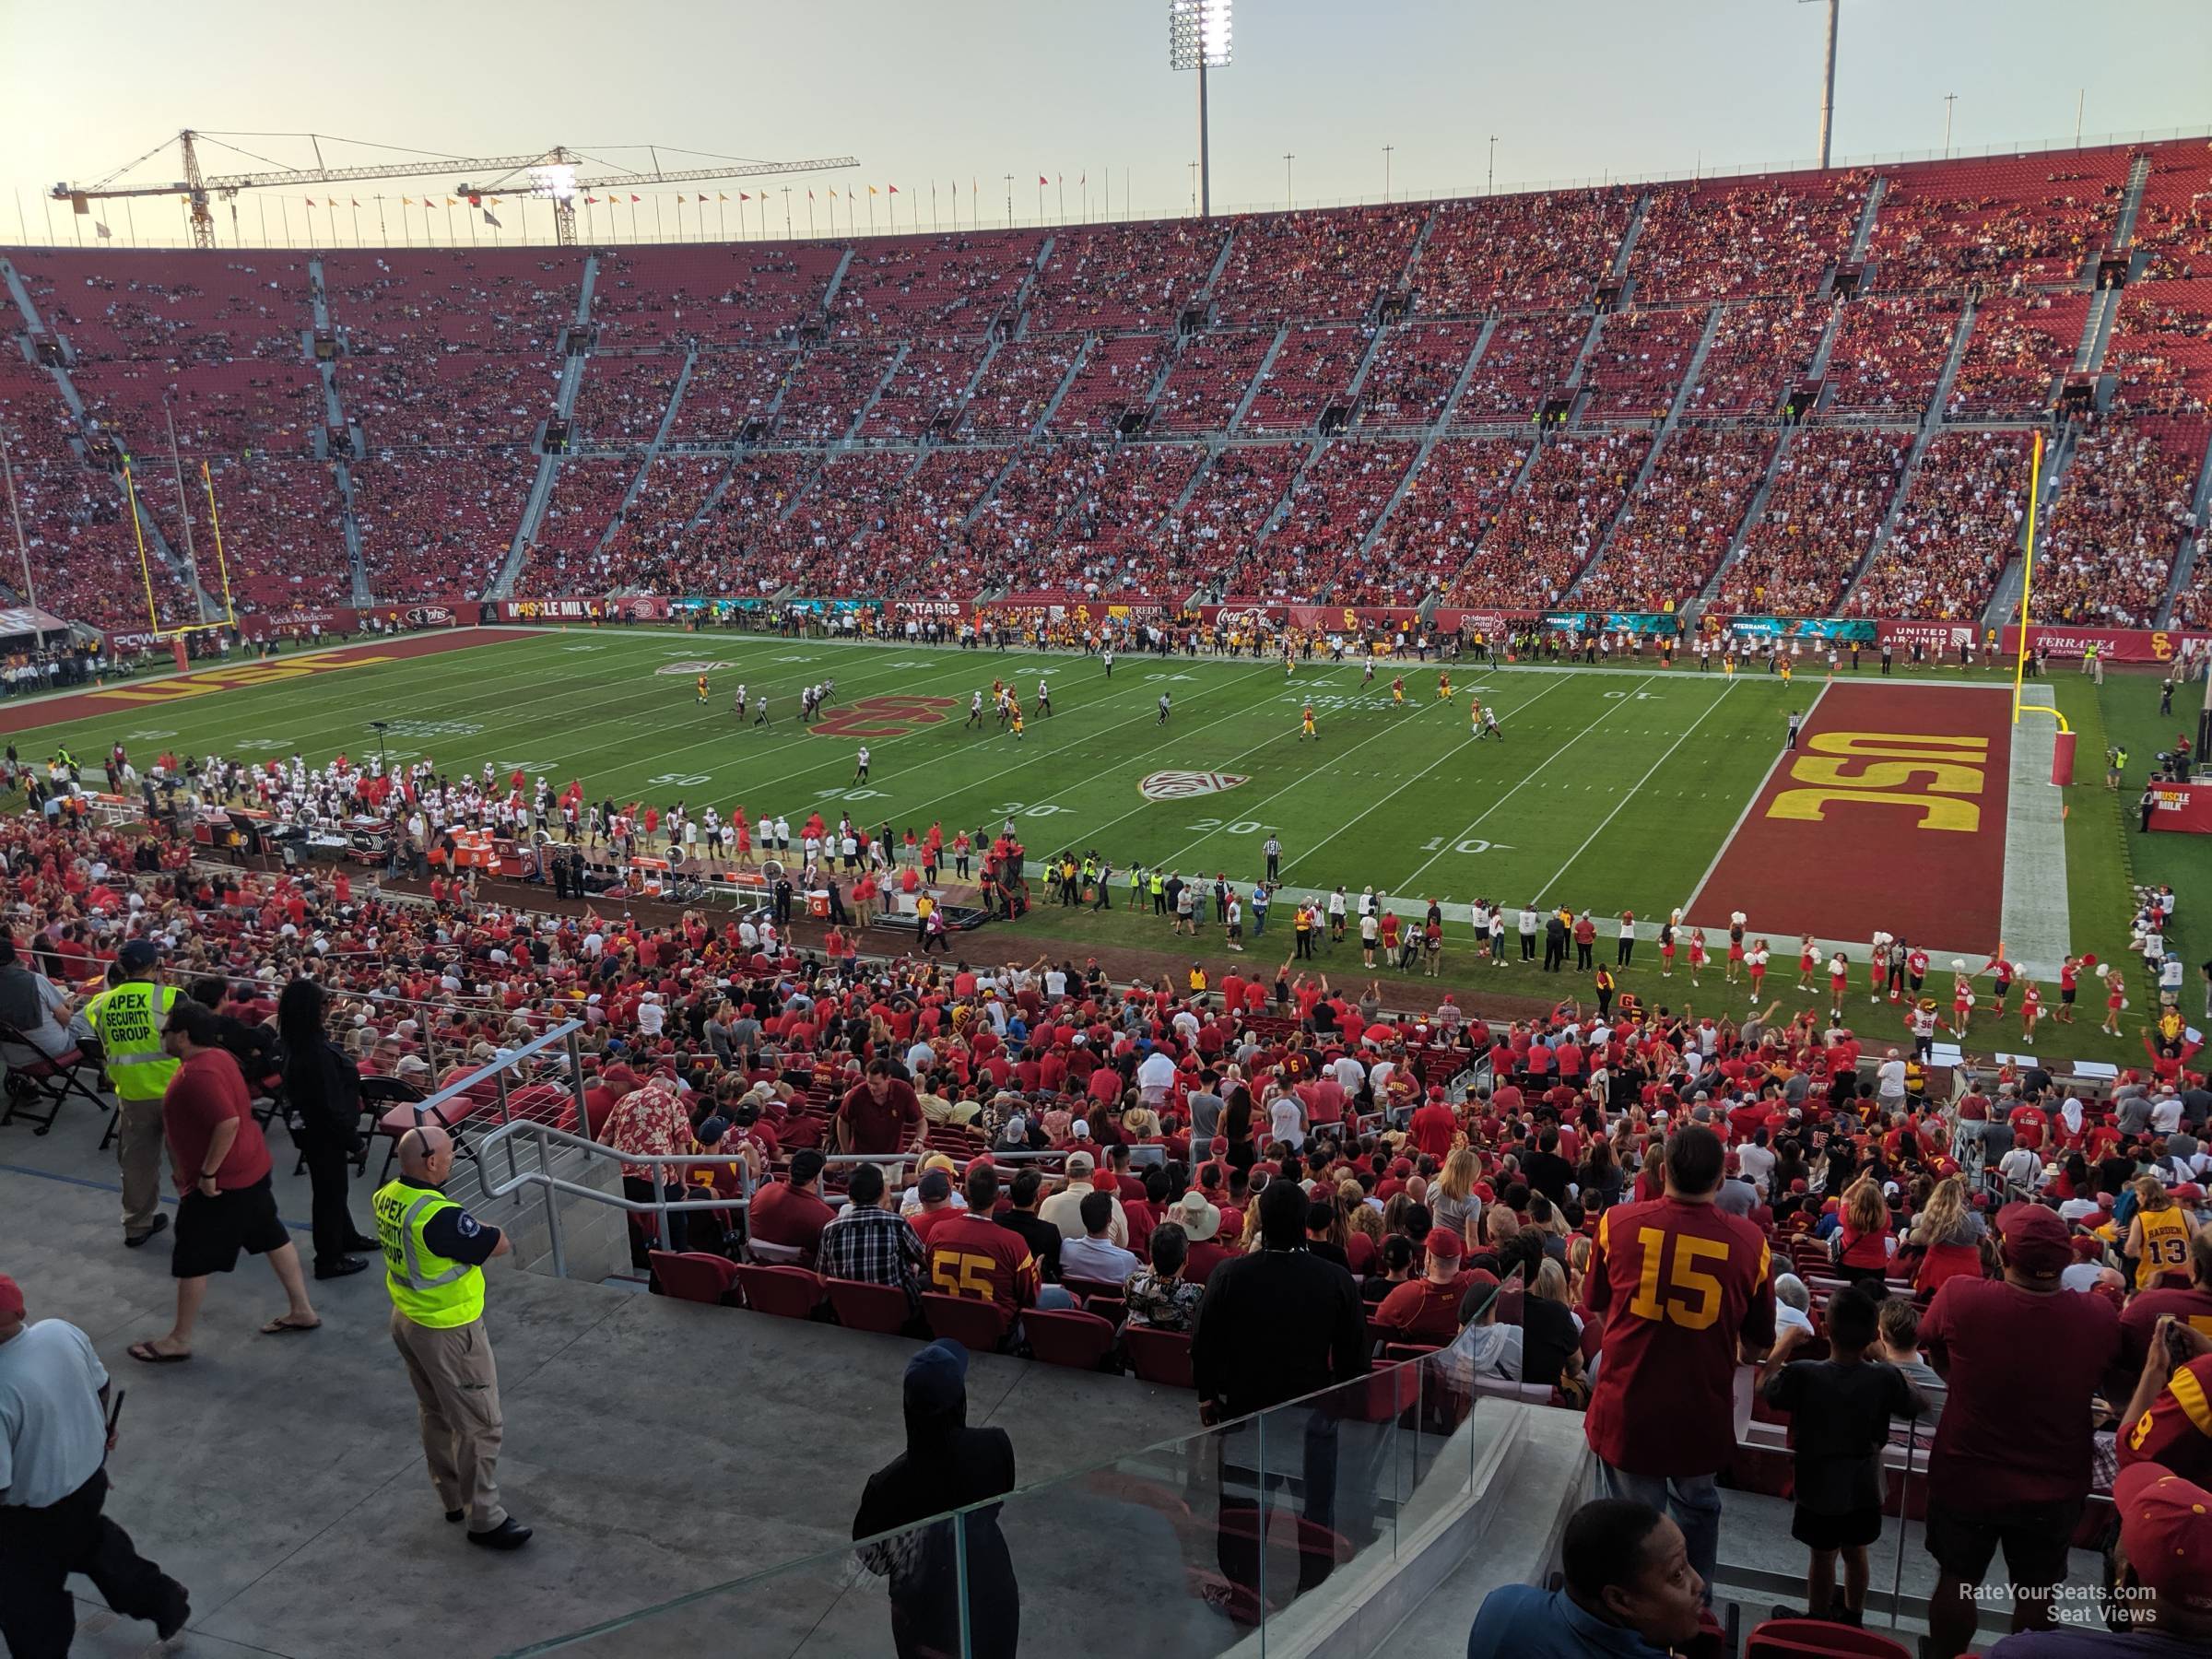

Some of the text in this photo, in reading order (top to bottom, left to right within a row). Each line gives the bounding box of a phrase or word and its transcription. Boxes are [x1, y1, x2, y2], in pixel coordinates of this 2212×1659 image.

[270, 612, 334, 626] Keck Medicine
[1896, 627, 1947, 636] UNITED
[1882, 636, 1947, 645] AIRLINES
[2035, 637, 2117, 651] TERRANEA
[85, 654, 399, 701] USC
[647, 772, 712, 786] 50
[1764, 731, 1990, 833] USC
[813, 786, 878, 801] 40
[2153, 790, 2191, 803] MUSCLE
[990, 802, 1059, 818] 30
[2159, 800, 2182, 811] MILK
[1185, 818, 1262, 834] 20
[1419, 836, 1491, 853] 10
[813, 900, 821, 911] G
[108, 994, 147, 1010] APEX
[1622, 996, 1632, 1006] G
[106, 1010, 148, 1027] SECURITY
[1921, 1019, 1933, 1030] 96
[111, 1027, 150, 1042] GROUP
[1290, 1062, 1299, 1073] 6
[1180, 1082, 1188, 1094] 6
[1859, 1107, 1871, 1123] 7
[1812, 1130, 1830, 1149] 15
[378, 1196, 406, 1224] APEX
[2147, 1226, 2183, 1241] HARDEN
[2148, 1239, 2188, 1265] 13
[932, 1249, 996, 1302] 55
[1630, 1227, 1729, 1330] 15
